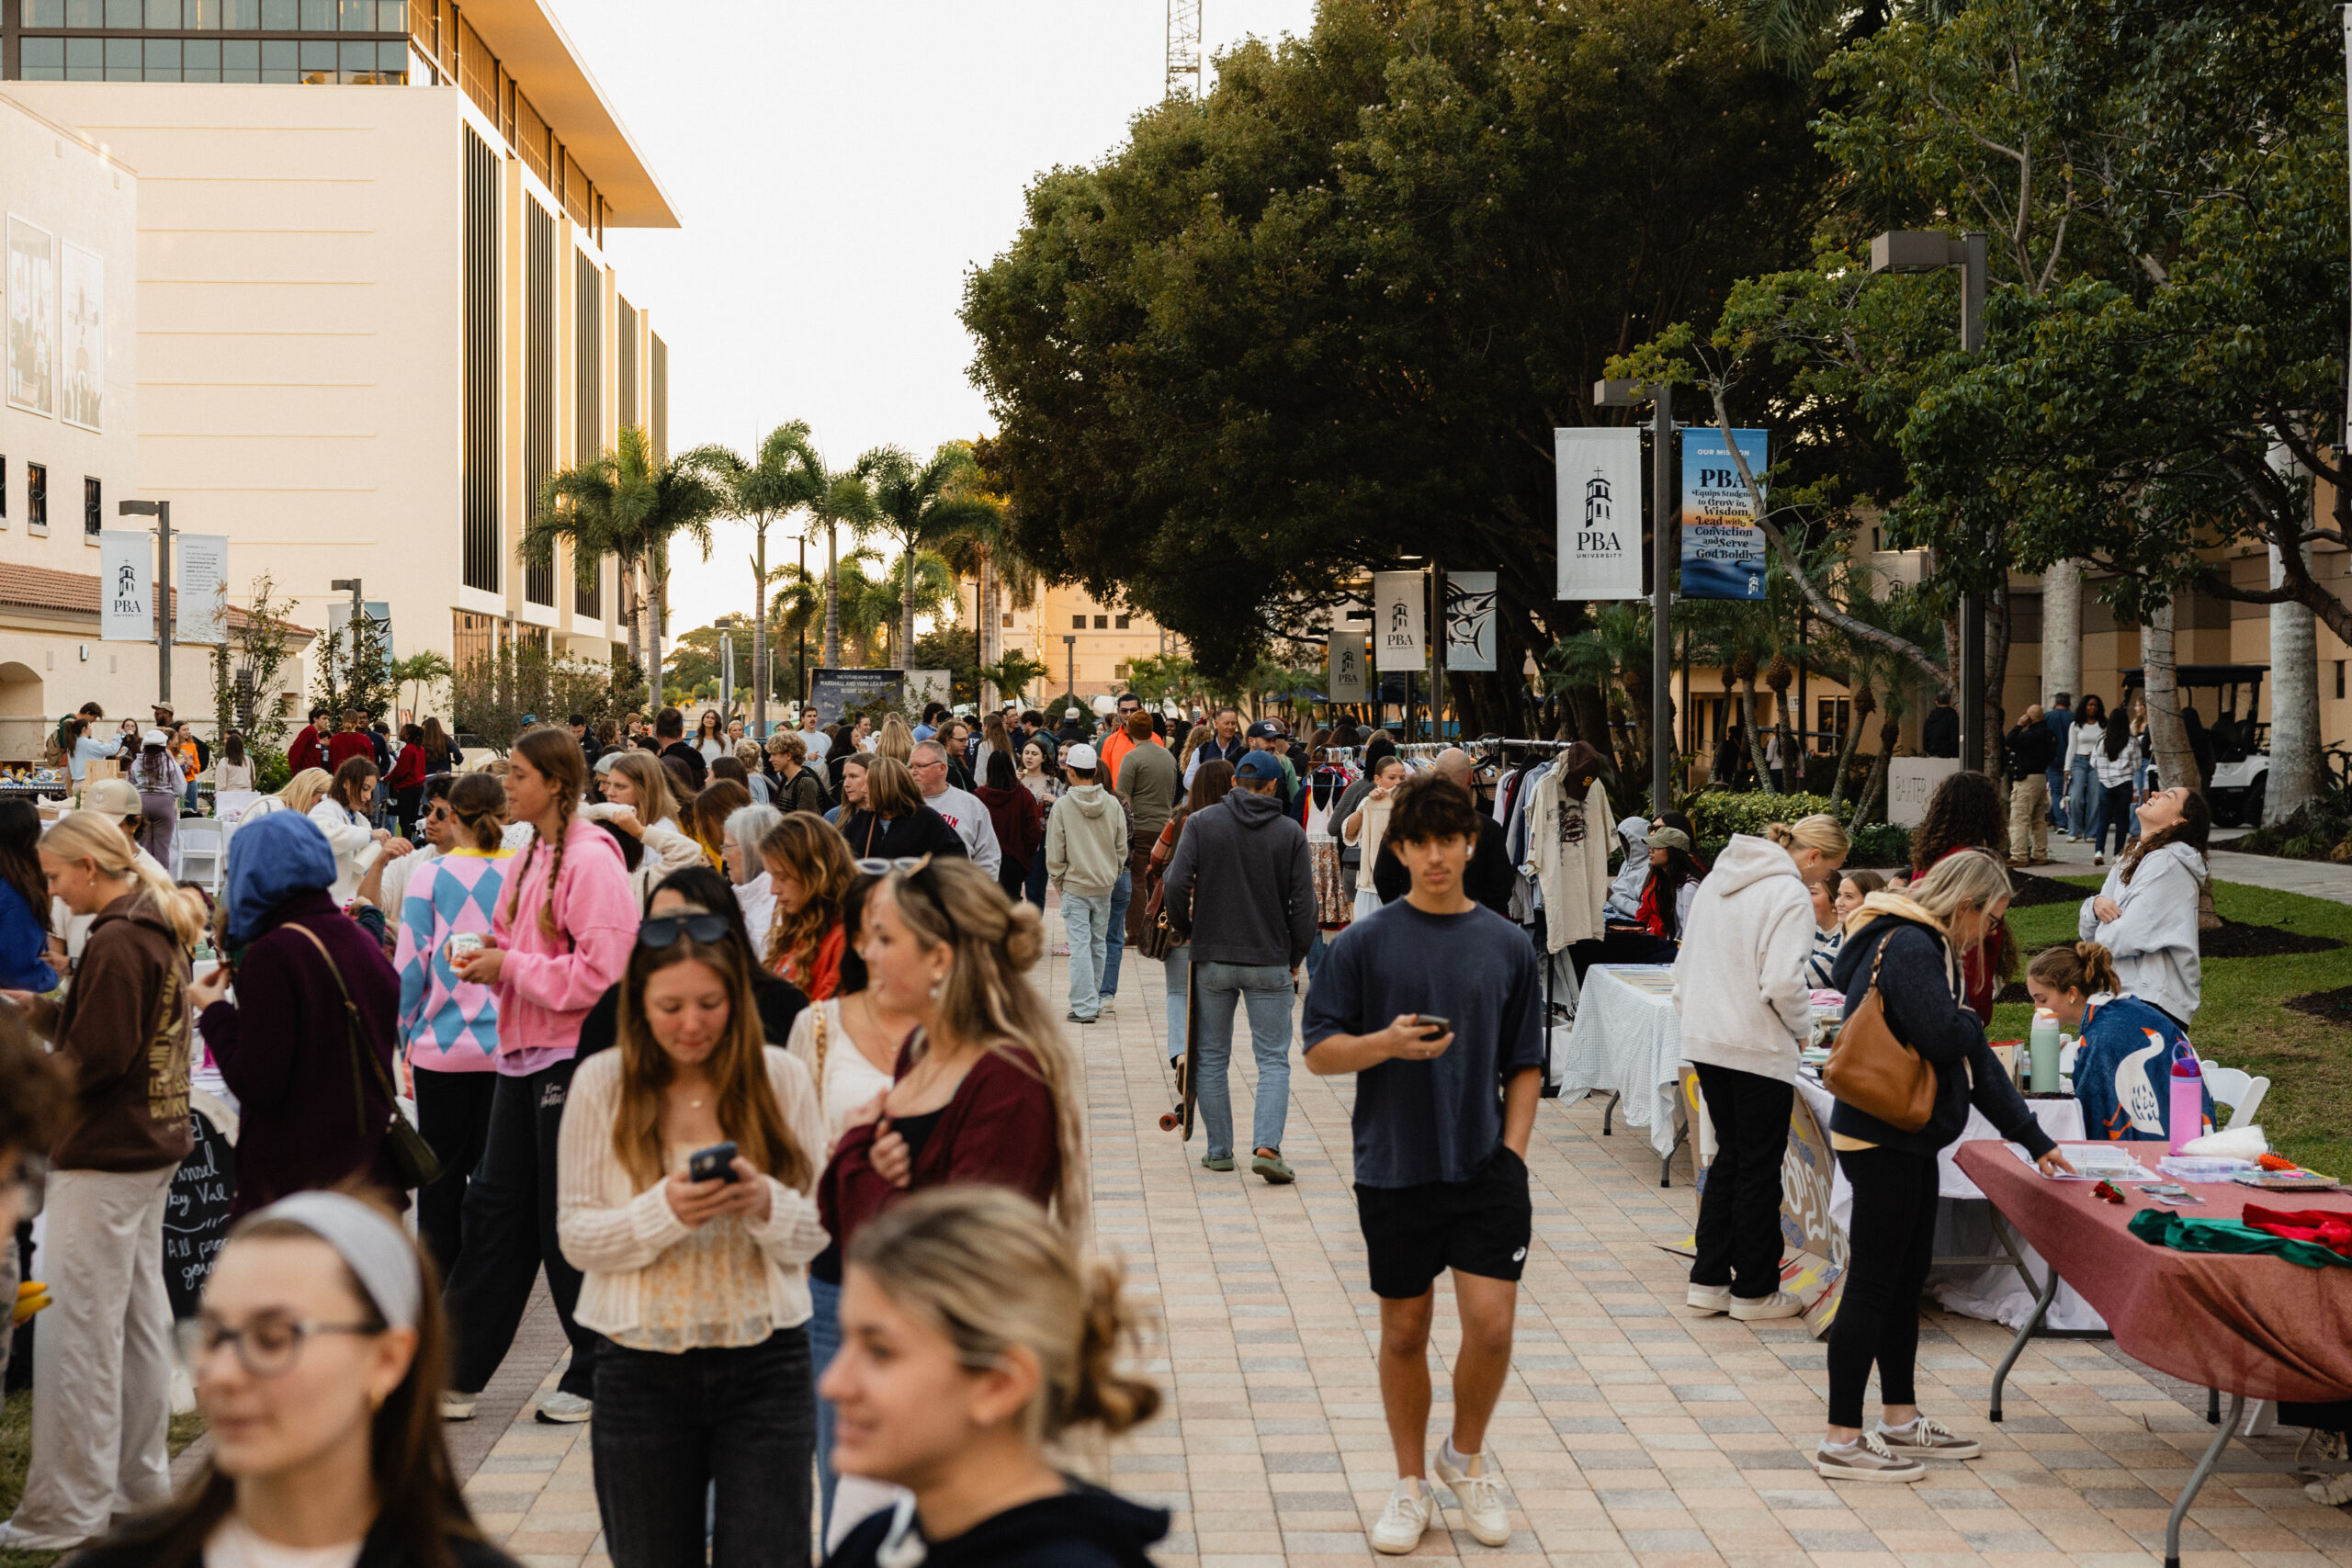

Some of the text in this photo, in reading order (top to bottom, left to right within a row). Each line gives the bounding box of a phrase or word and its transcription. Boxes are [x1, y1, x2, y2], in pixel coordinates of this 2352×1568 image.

[1699, 468, 1747, 489] PBA
[1691, 489, 1751, 498] Equips Studen
[1708, 498, 1735, 506] Grow
[1704, 506, 1751, 518] Wisdom,
[1695, 515, 1746, 526] Lead with
[1695, 526, 1753, 536] Conviction
[1577, 532, 1622, 551] PBA
[1702, 536, 1748, 547] and Serve
[1696, 548, 1757, 563] God Boldly.
[114, 600, 141, 613] PBA
[1387, 634, 1414, 646] PBA
[1338, 673, 1359, 682] PBA
[1895, 775, 1927, 804] BAXTER
[940, 813, 959, 829] SIN
[177, 1141, 220, 1183] insel
[168, 1182, 230, 1217] by Val
[167, 1237, 192, 1258] All
[181, 1261, 218, 1292] goin
